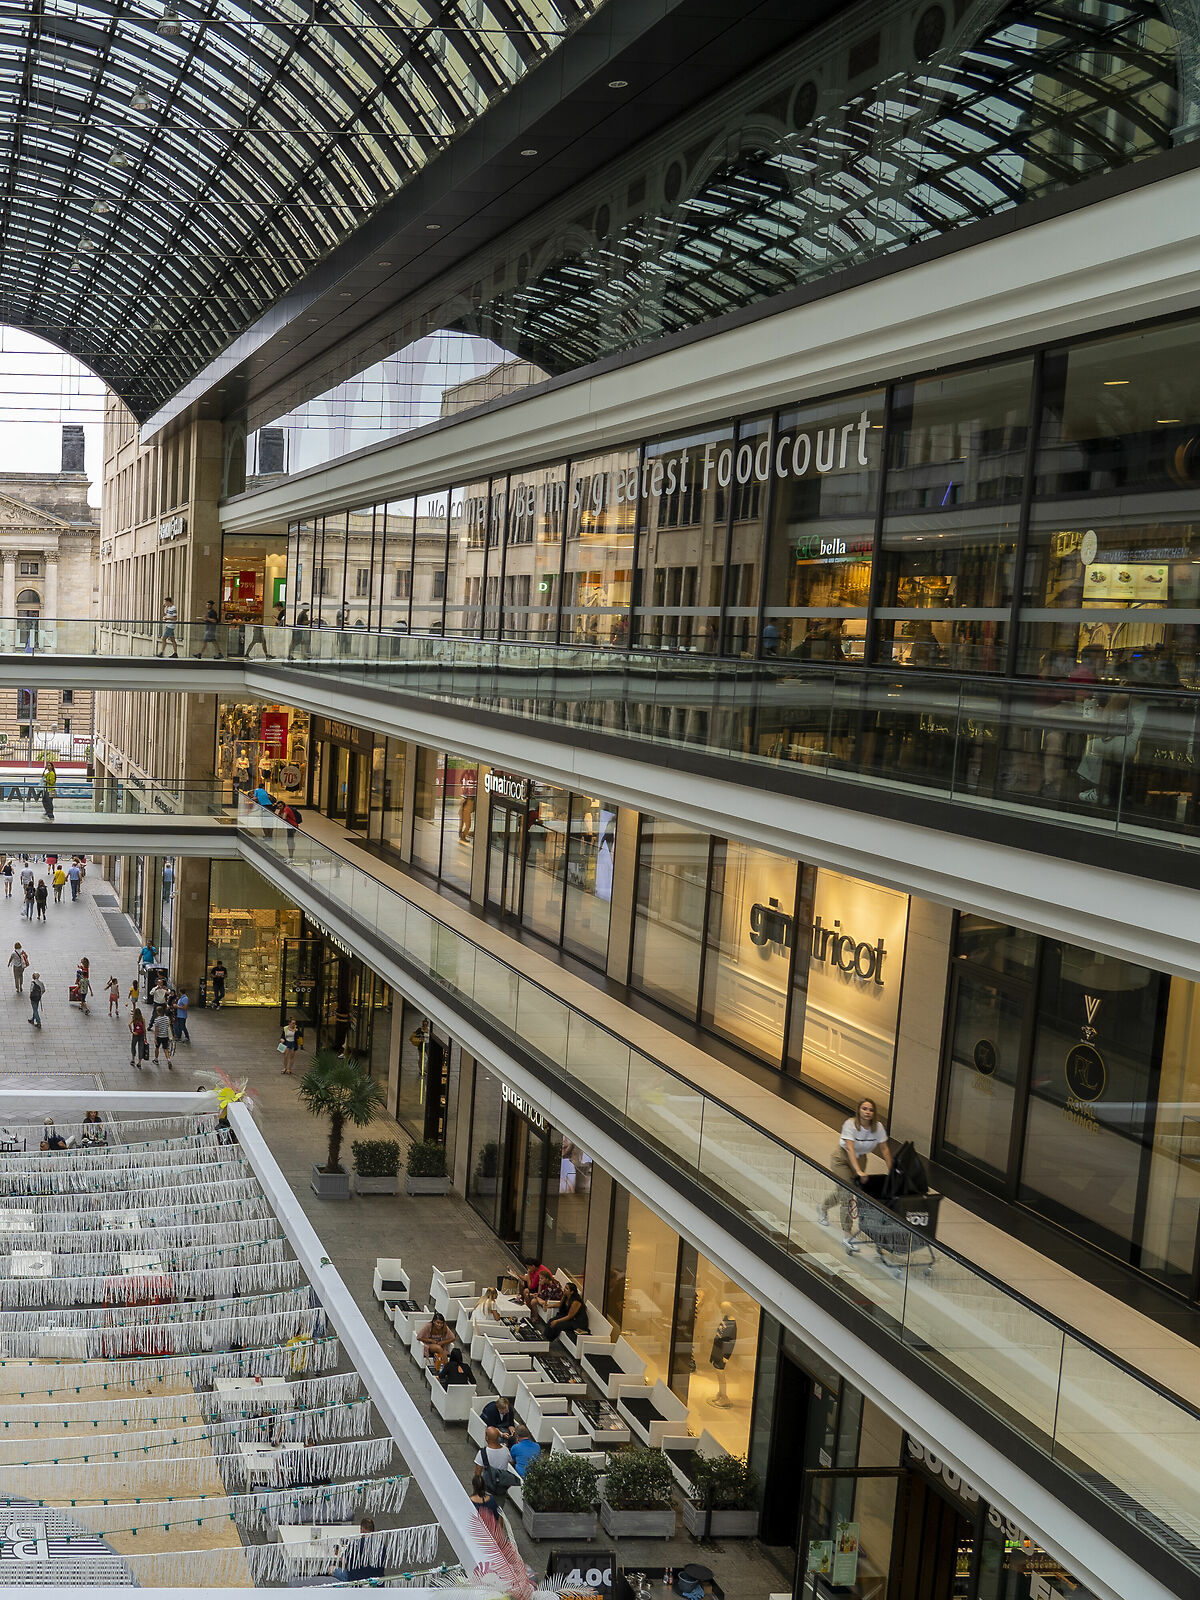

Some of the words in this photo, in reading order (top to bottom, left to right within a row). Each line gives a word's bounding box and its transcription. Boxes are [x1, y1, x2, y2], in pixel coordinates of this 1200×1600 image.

[428, 496, 485, 527] Wecome
[592, 448, 689, 517] greatest
[703, 410, 871, 491] Foodcourt
[820, 538, 847, 555] bella
[749, 897, 887, 985] gintricot
[1061, 1107, 1099, 1133] LOUNGE
[1066, 1096, 1096, 1120] ROYAL
